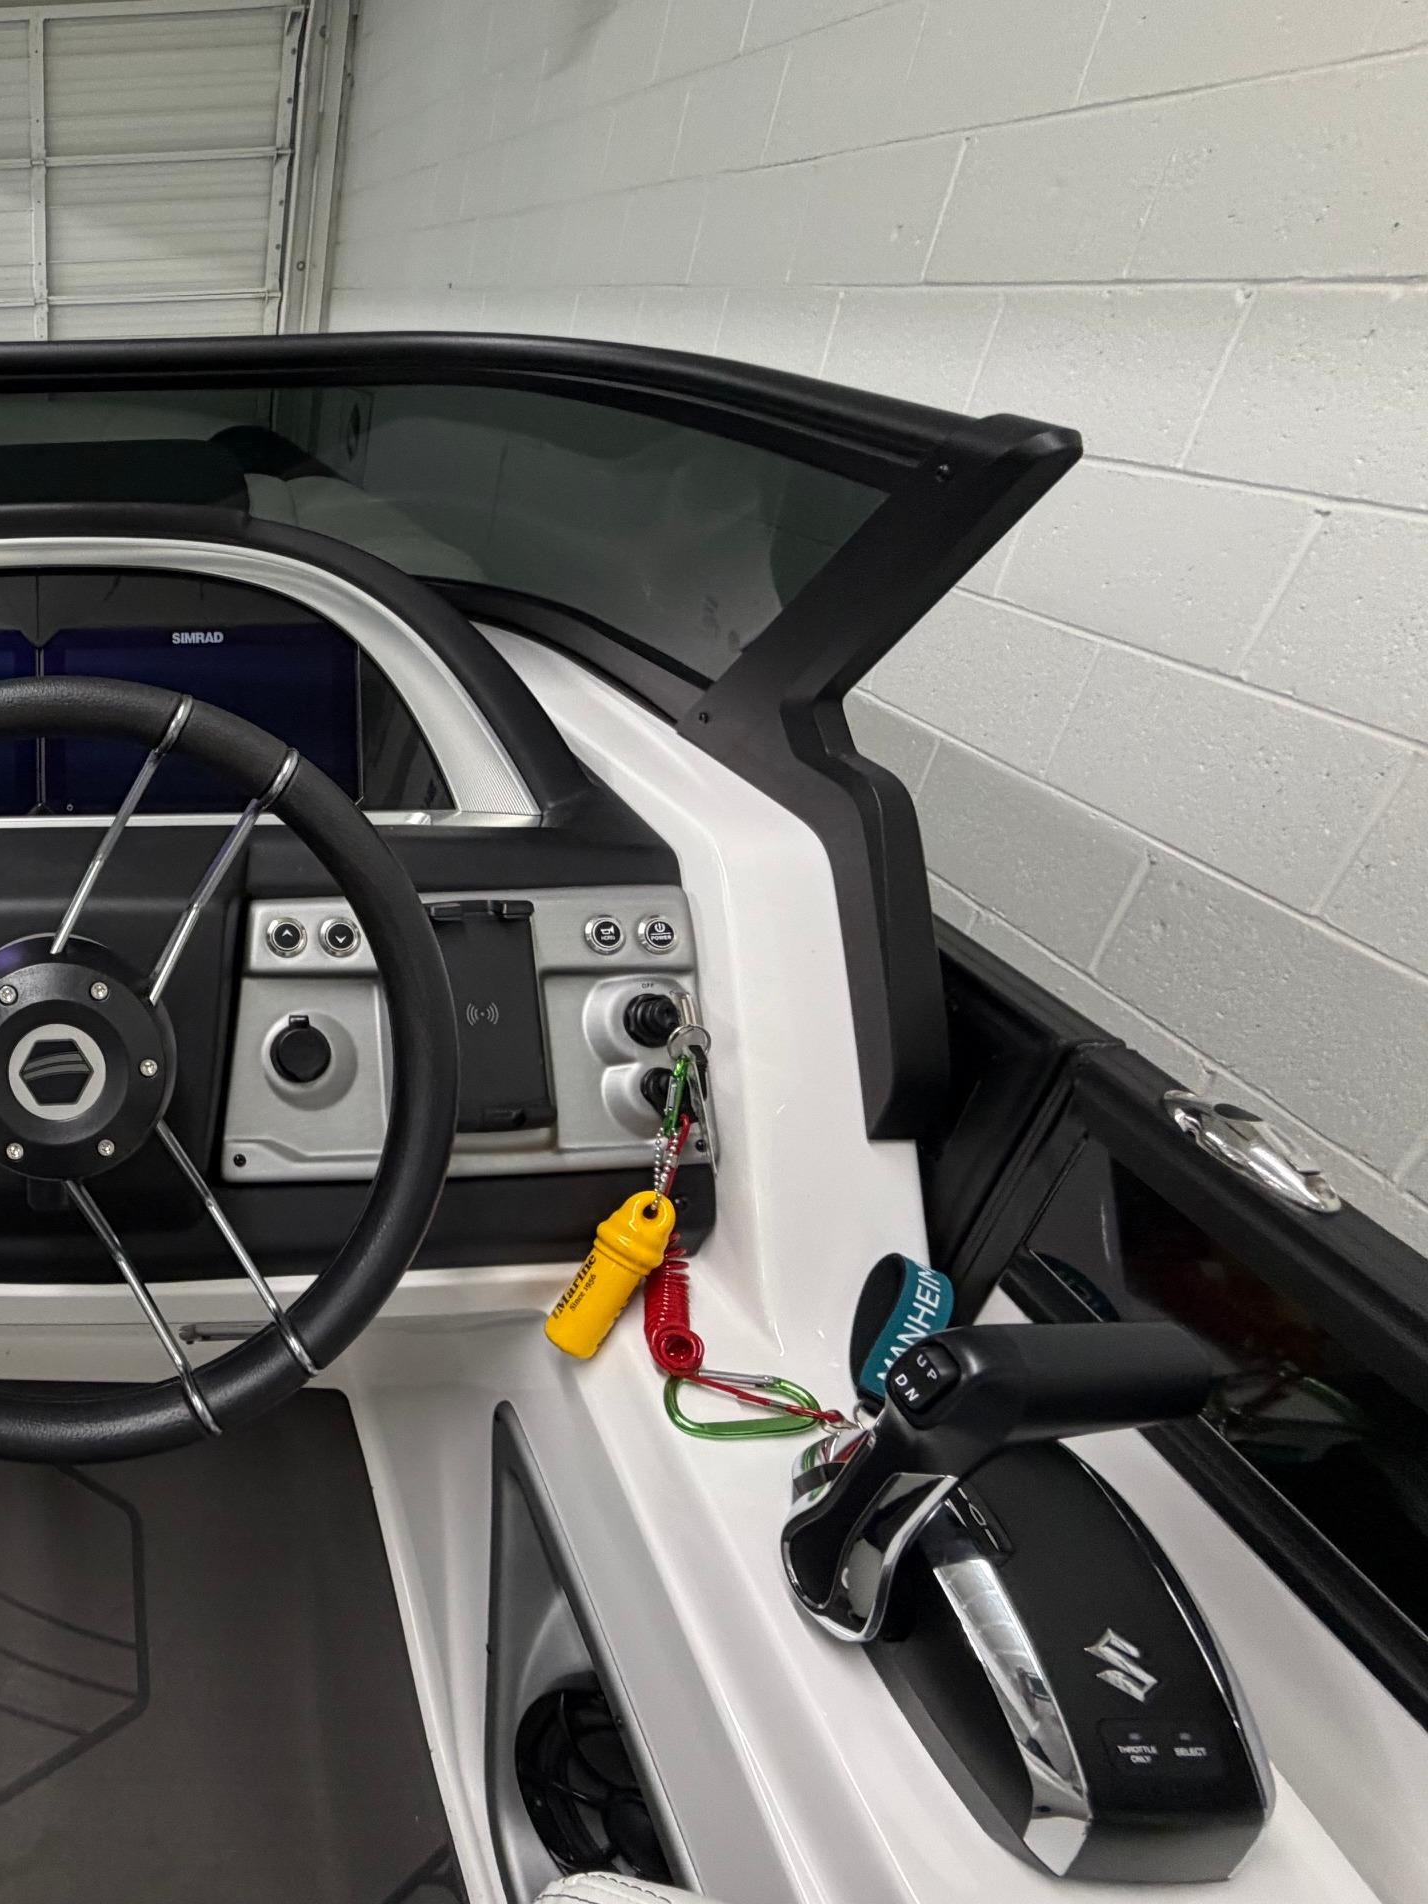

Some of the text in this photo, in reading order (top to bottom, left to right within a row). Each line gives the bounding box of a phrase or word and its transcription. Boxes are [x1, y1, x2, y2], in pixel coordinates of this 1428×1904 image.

[172, 631, 224, 645] SIMRAD
[583, 1274, 597, 1292] 1956
[916, 1354, 938, 1381] UP
[894, 1373, 920, 1402] DN
[1117, 1745, 1158, 1754] THROTTLE
[1174, 1747, 1207, 1757] SELECT
[1130, 1755, 1152, 1764] ONLY
